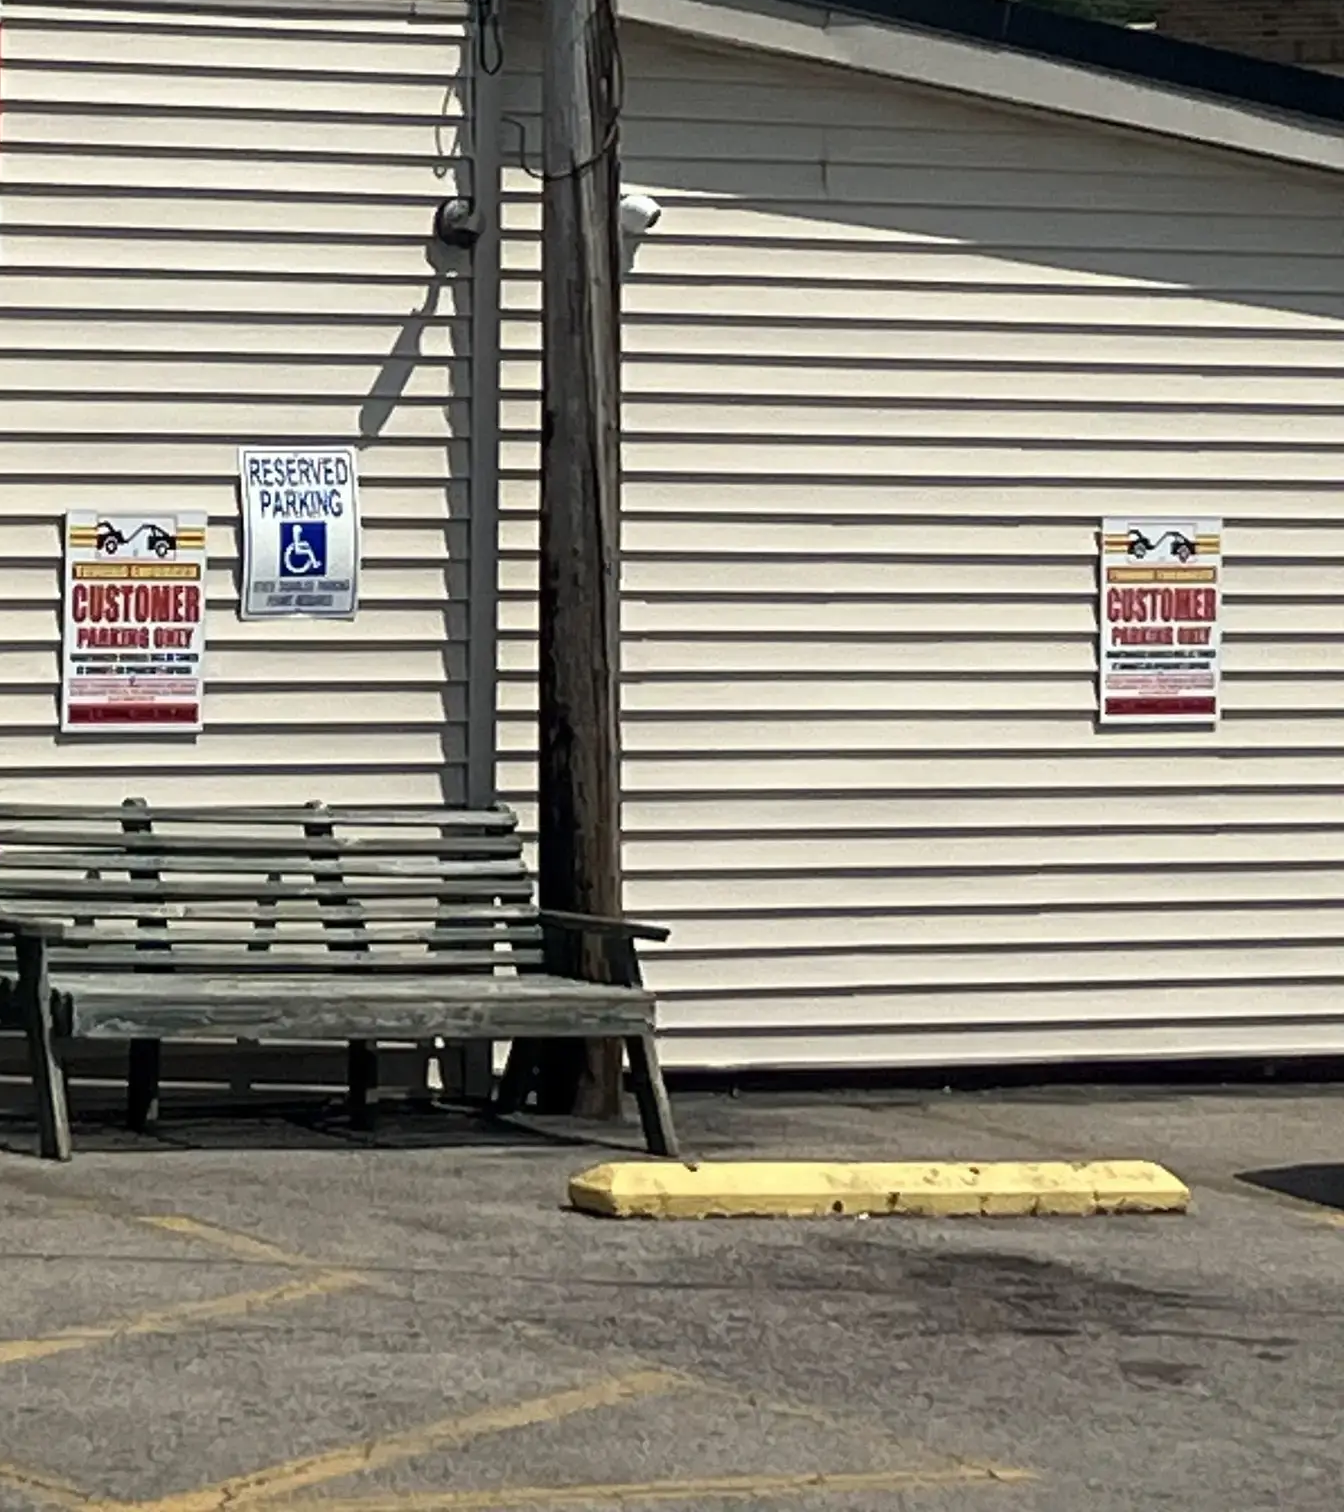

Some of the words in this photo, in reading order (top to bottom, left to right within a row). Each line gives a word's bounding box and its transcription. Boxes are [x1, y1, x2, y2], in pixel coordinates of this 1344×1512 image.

[249, 456, 349, 488] RESERVED
[259, 489, 344, 519] PARKING
[71, 583, 201, 624] CUSTOMER
[1107, 587, 1216, 622] CUSTOMER
[76, 626, 150, 649] PARKING
